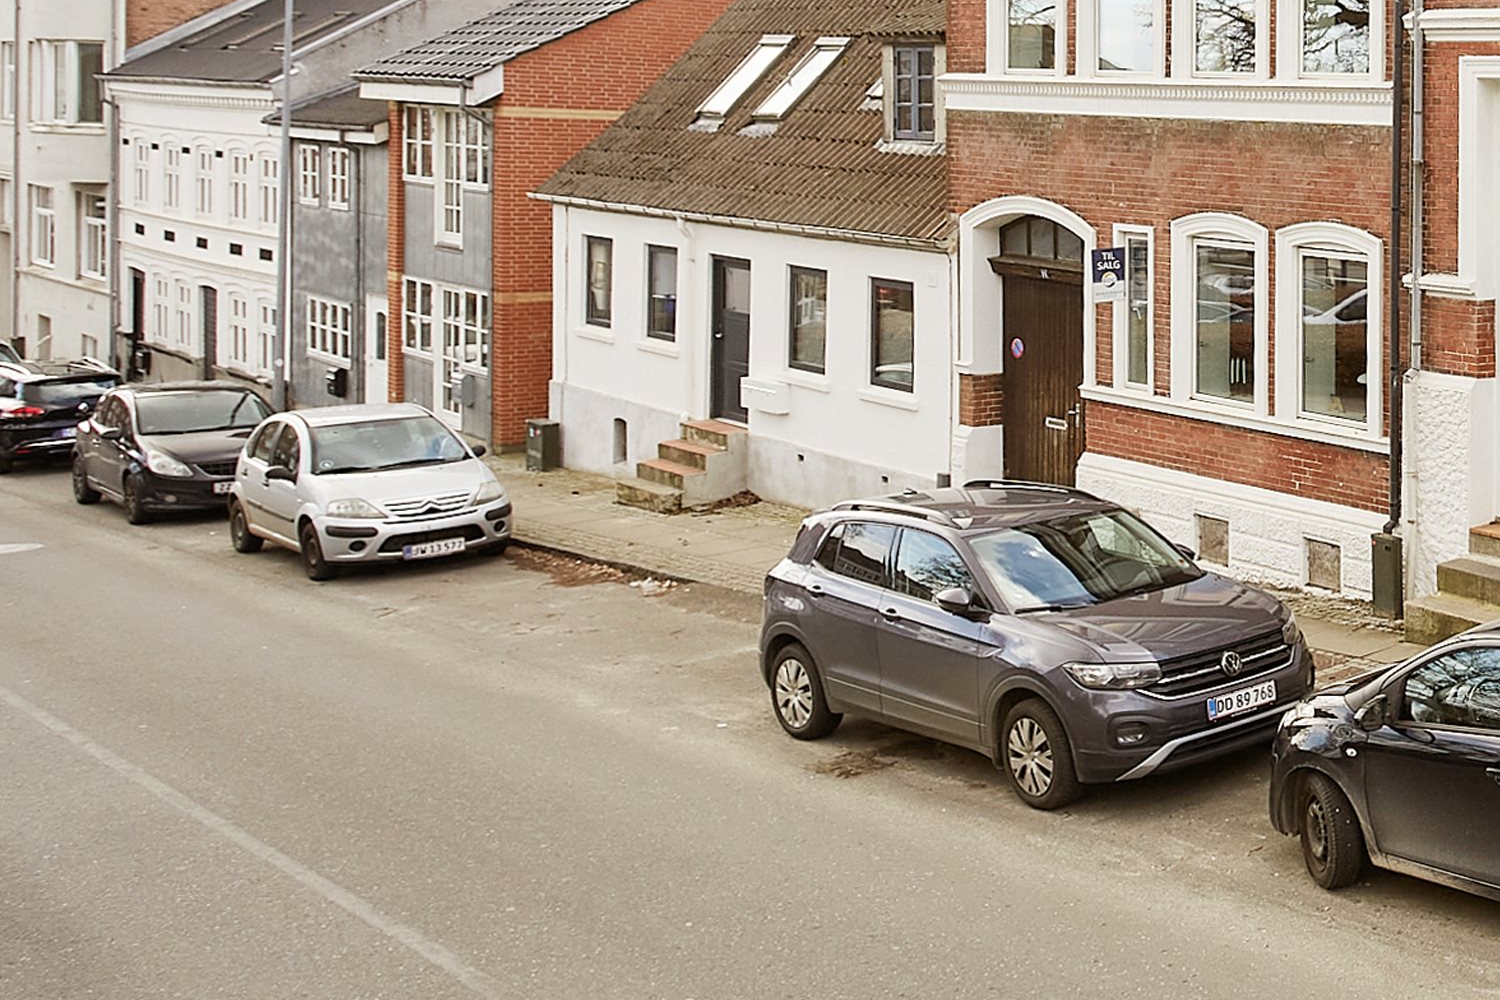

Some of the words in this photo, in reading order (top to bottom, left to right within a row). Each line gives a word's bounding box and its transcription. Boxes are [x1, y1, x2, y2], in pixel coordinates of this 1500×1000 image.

[1101, 251, 1116, 260] TIL
[1096, 260, 1121, 271] SALG
[1217, 697, 1234, 713] DD
[1236, 692, 1251, 708] 89
[1253, 685, 1274, 702] 768
